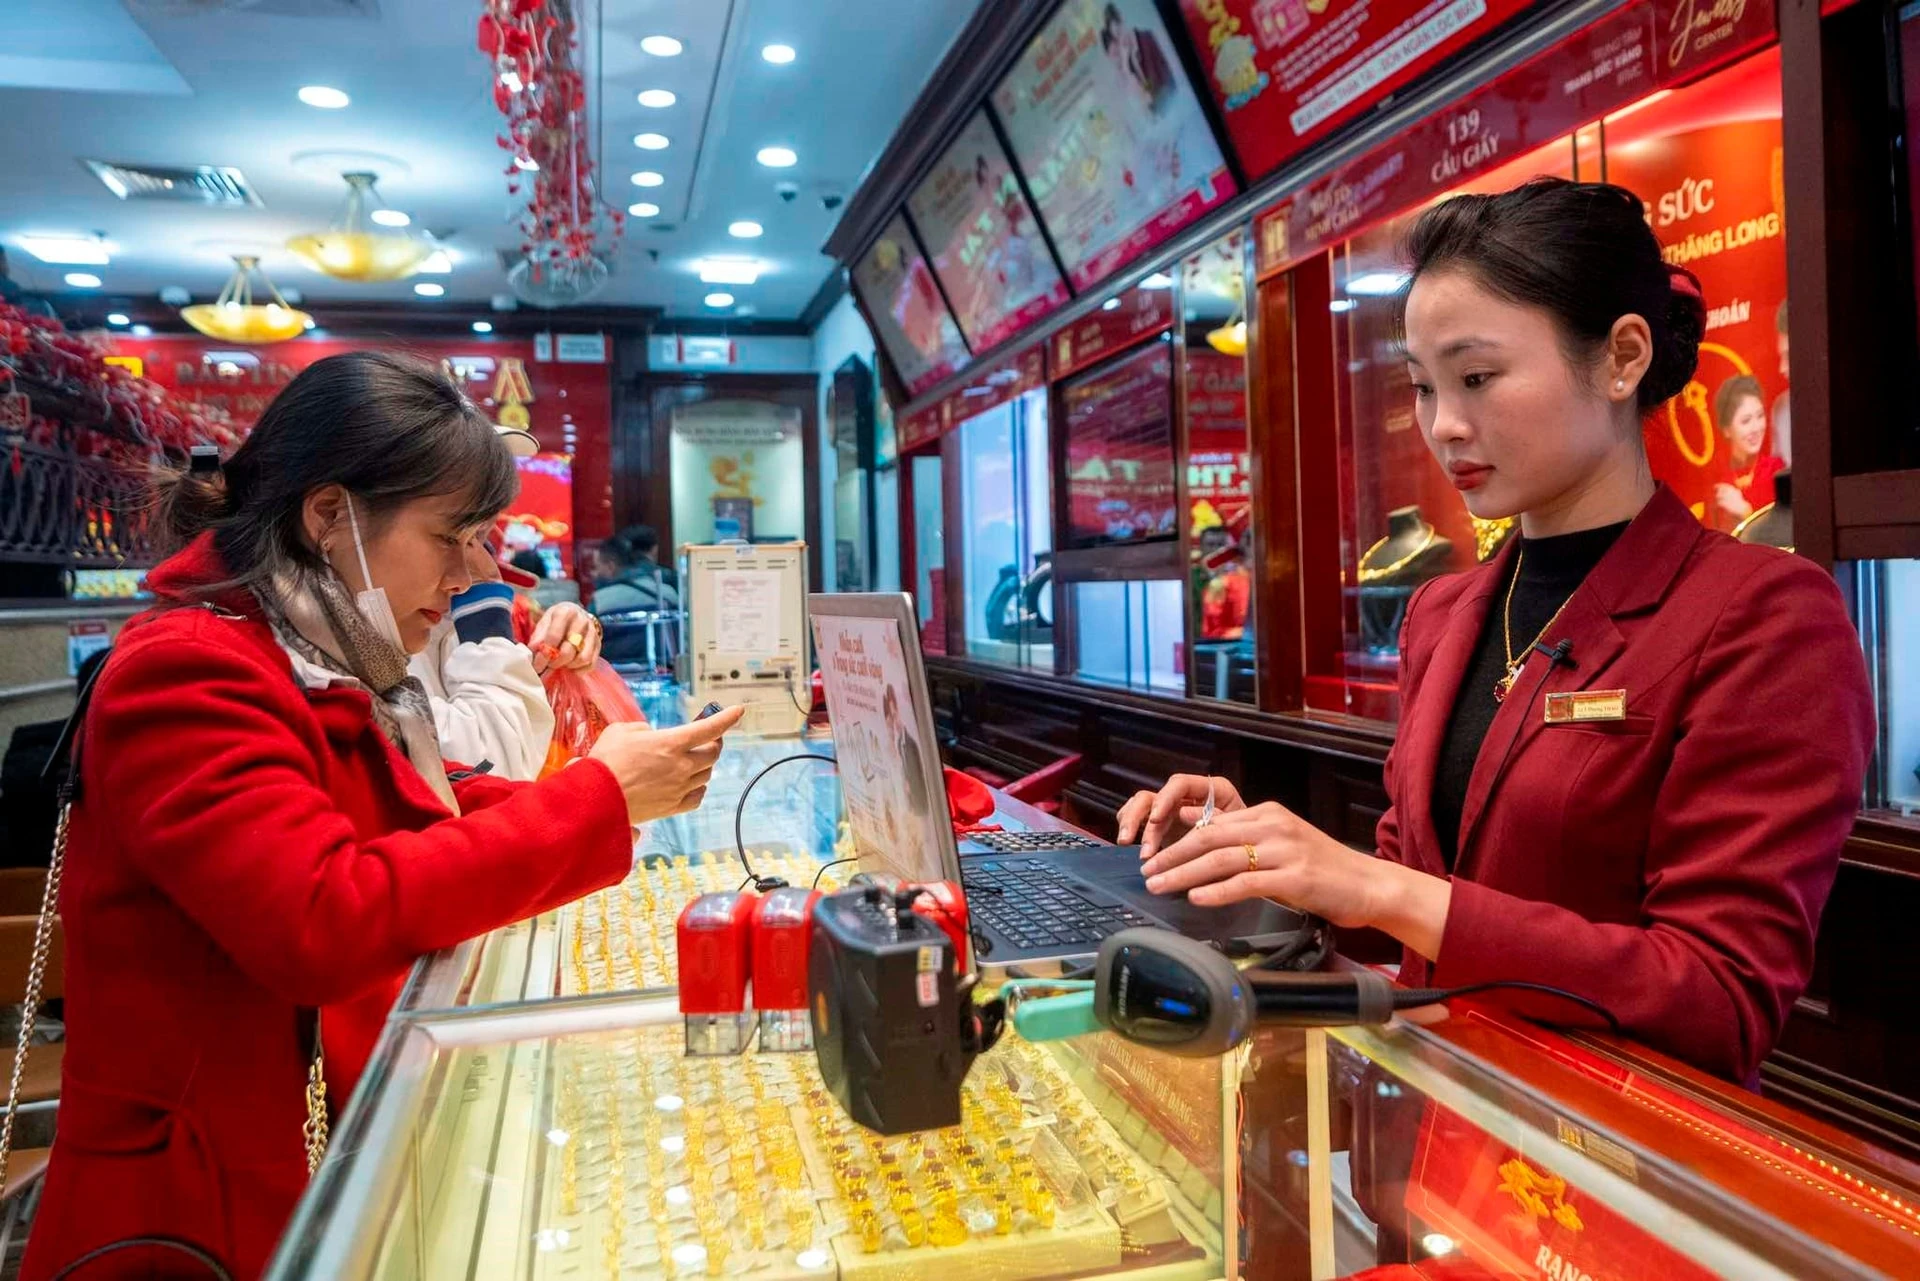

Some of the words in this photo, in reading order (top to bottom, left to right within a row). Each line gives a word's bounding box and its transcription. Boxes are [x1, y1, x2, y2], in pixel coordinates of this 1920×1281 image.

[1694, 22, 1733, 50] CENTER
[1448, 108, 1480, 147] 139
[1431, 148, 1461, 183] CẦU
[1462, 126, 1500, 169] GIẤY
[1658, 177, 1715, 227] SỨC
[1662, 230, 1724, 265] THĂNG
[1724, 211, 1780, 251] LONG
